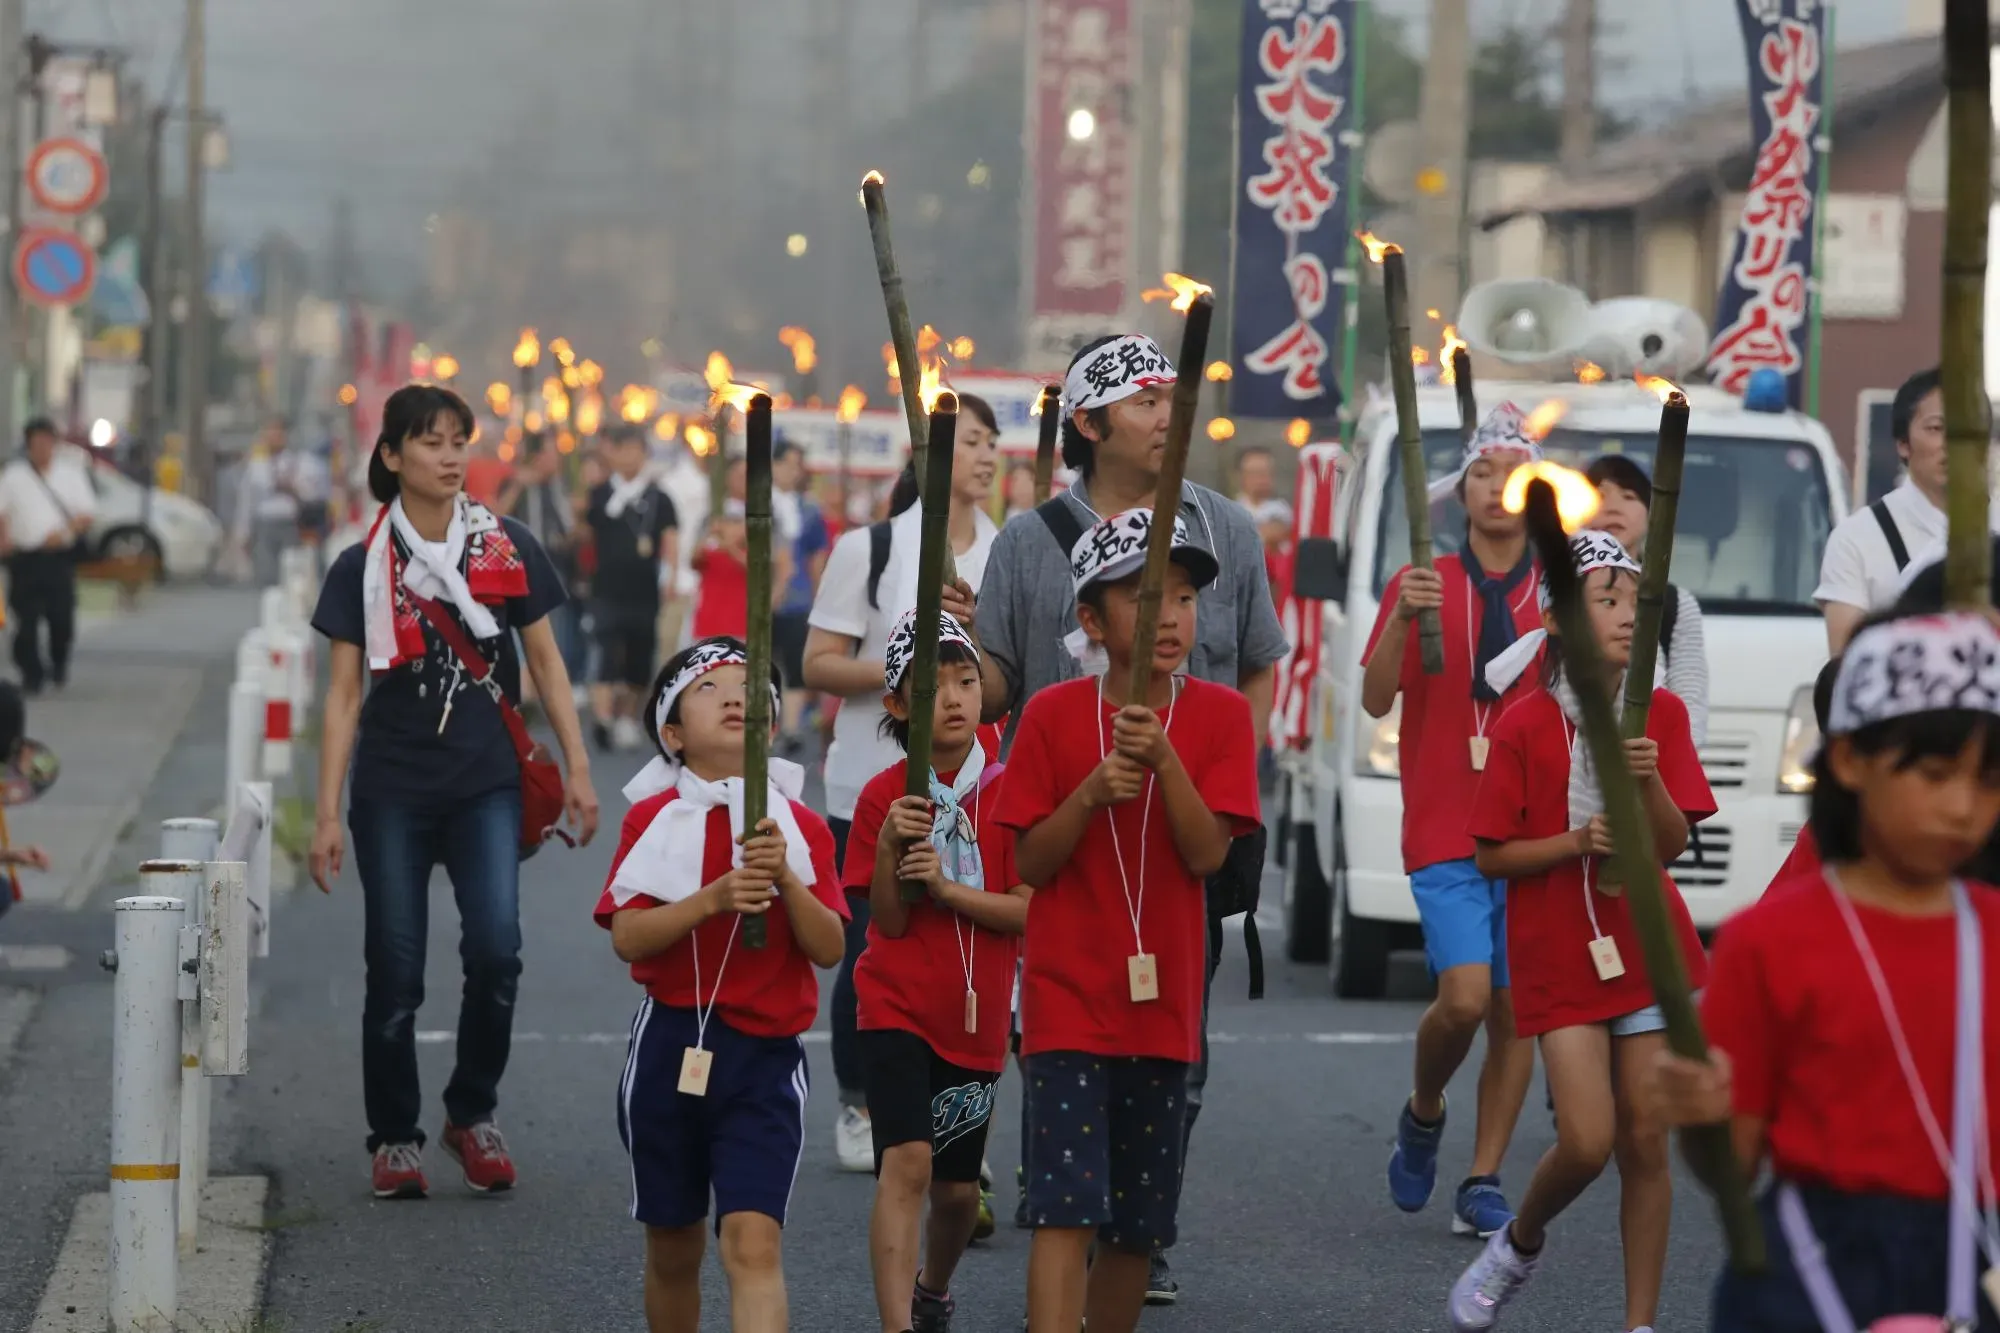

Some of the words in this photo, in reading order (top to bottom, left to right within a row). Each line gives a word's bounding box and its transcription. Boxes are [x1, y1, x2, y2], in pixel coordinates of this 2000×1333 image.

[1707, 0, 1819, 397] 火祭りの会
